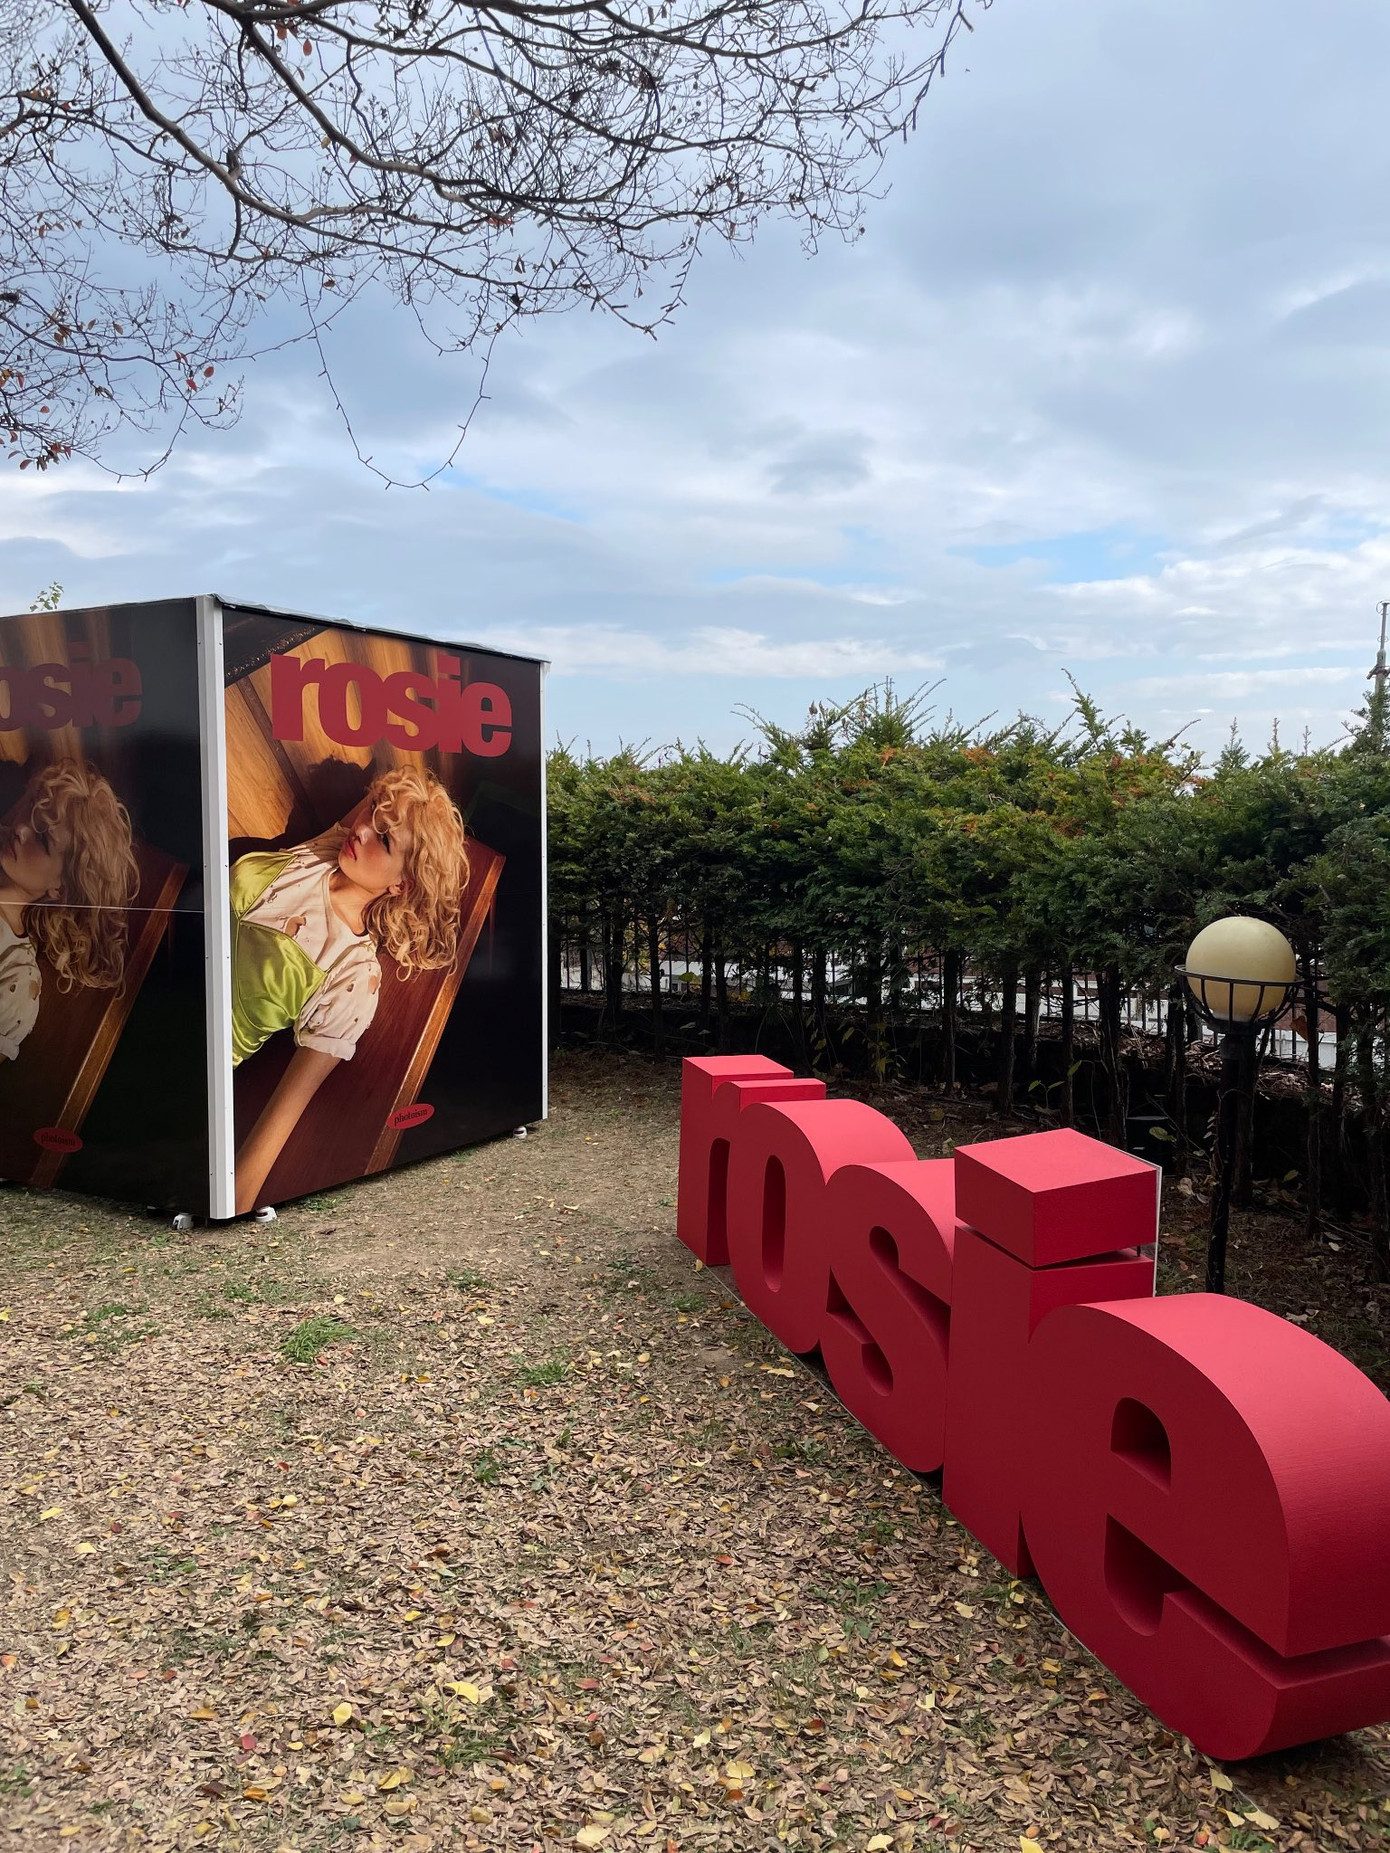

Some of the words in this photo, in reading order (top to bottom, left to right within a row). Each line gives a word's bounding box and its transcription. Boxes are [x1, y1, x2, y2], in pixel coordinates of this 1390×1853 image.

[270, 654, 512, 757] rosie
[41, 1131, 76, 1147] photoism
[394, 1108, 428, 1127] photoism
[676, 1054, 1390, 1761] rosie
